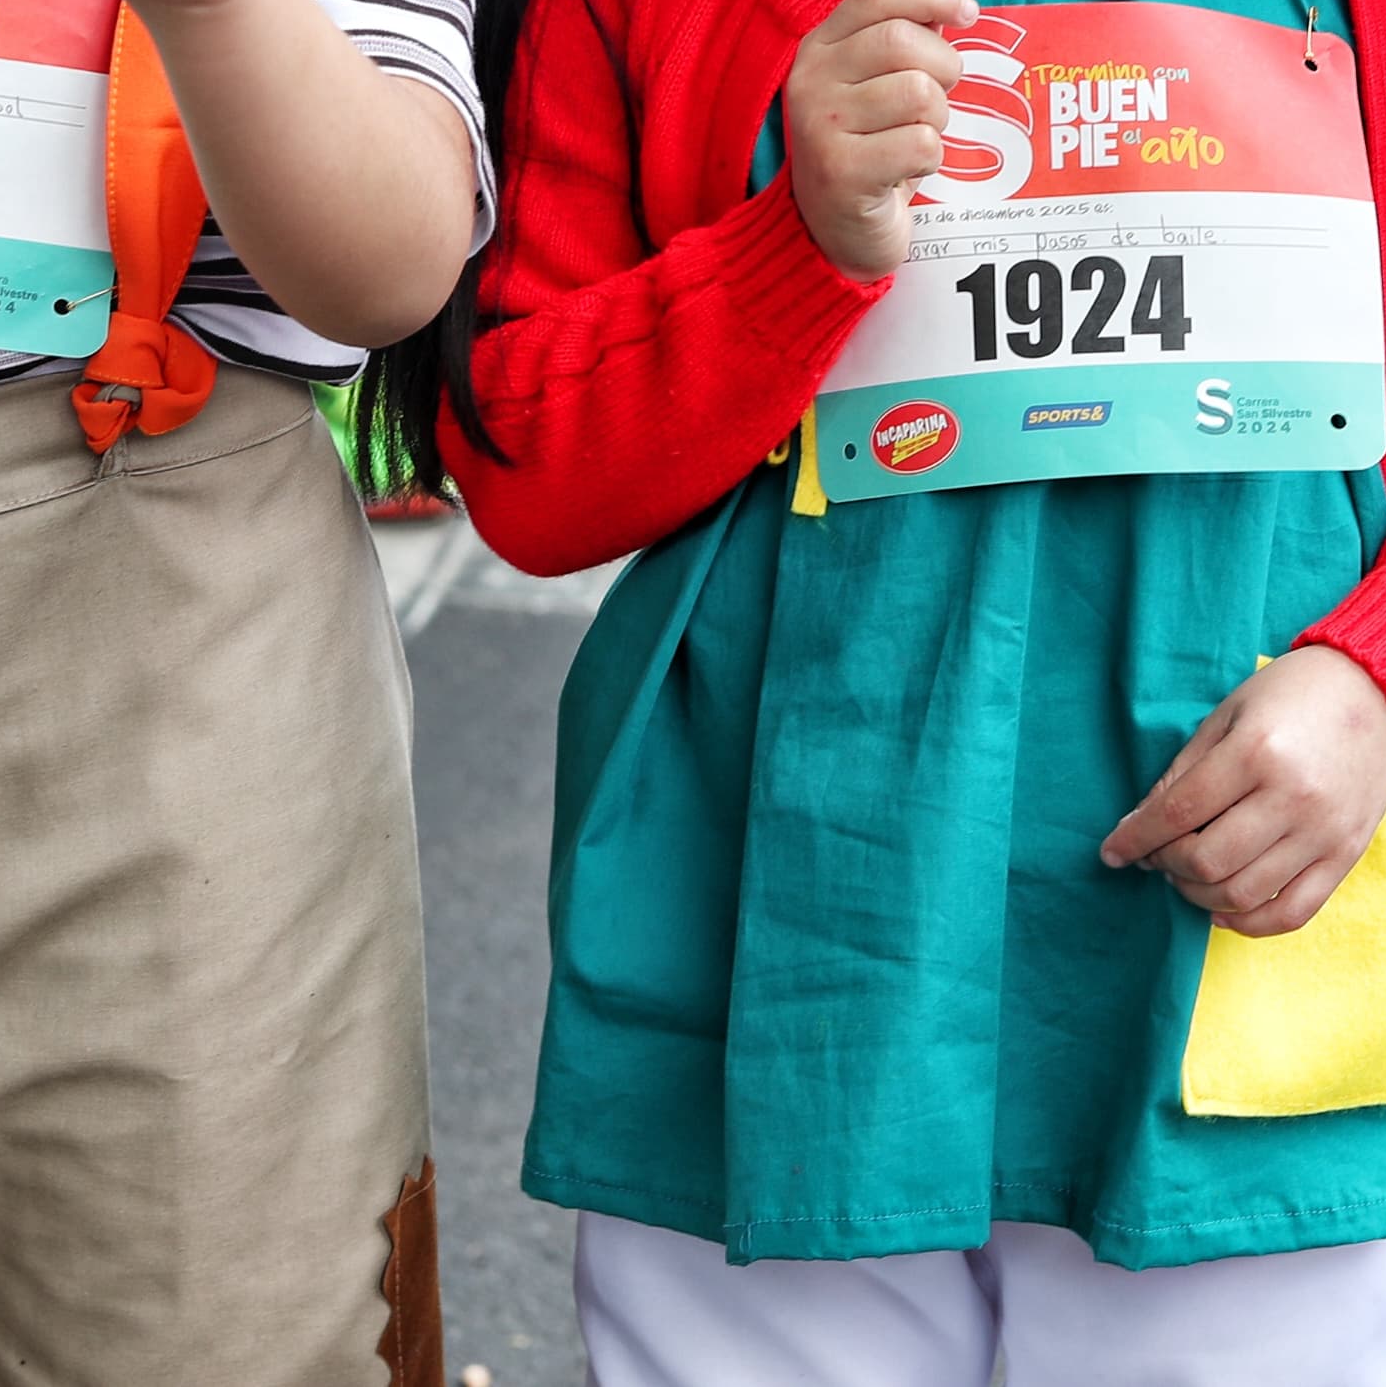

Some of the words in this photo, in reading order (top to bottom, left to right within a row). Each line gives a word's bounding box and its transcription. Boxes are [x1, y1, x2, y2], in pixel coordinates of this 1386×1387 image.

[1153, 67, 1190, 83] con
[1049, 79, 1168, 124] BUEN
[1050, 123, 1119, 169] PIE
[1140, 126, 1224, 169] año
[913, 213, 931, 225] 31
[935, 211, 955, 223] de
[959, 207, 1034, 223] diciembre
[1040, 202, 1090, 216] 2025
[973, 236, 1010, 254] mis
[1112, 222, 1139, 247] de
[956, 255, 1193, 362] 1924
[1236, 397, 1280, 407] Carrera
[1236, 408, 1259, 419] San
[1261, 408, 1312, 419] Silvestre
[1028, 405, 1104, 425] SPORTS&
[876, 413, 949, 448] INCAPARINA
[1236, 421, 1292, 434] 2024
